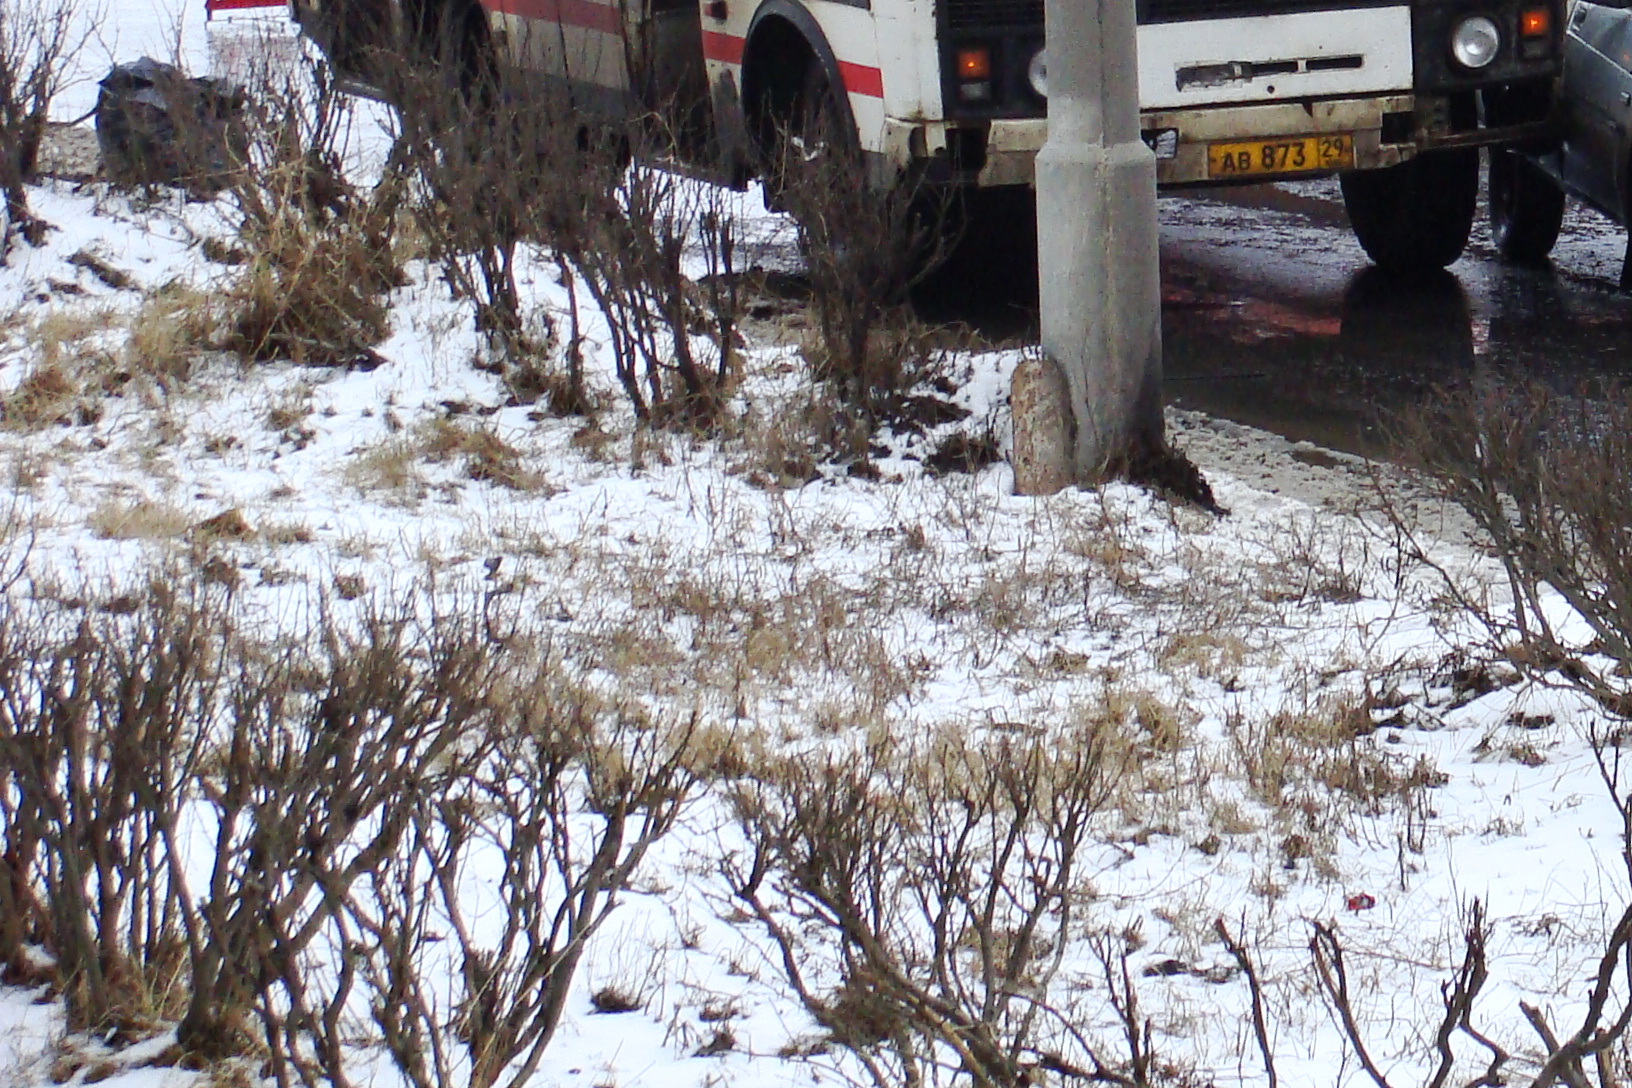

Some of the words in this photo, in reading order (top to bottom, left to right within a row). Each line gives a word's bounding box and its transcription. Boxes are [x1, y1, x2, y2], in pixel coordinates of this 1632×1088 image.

[1221, 151, 1251, 172] АВ
[1260, 143, 1306, 171] 873
[1320, 137, 1345, 159] 29
